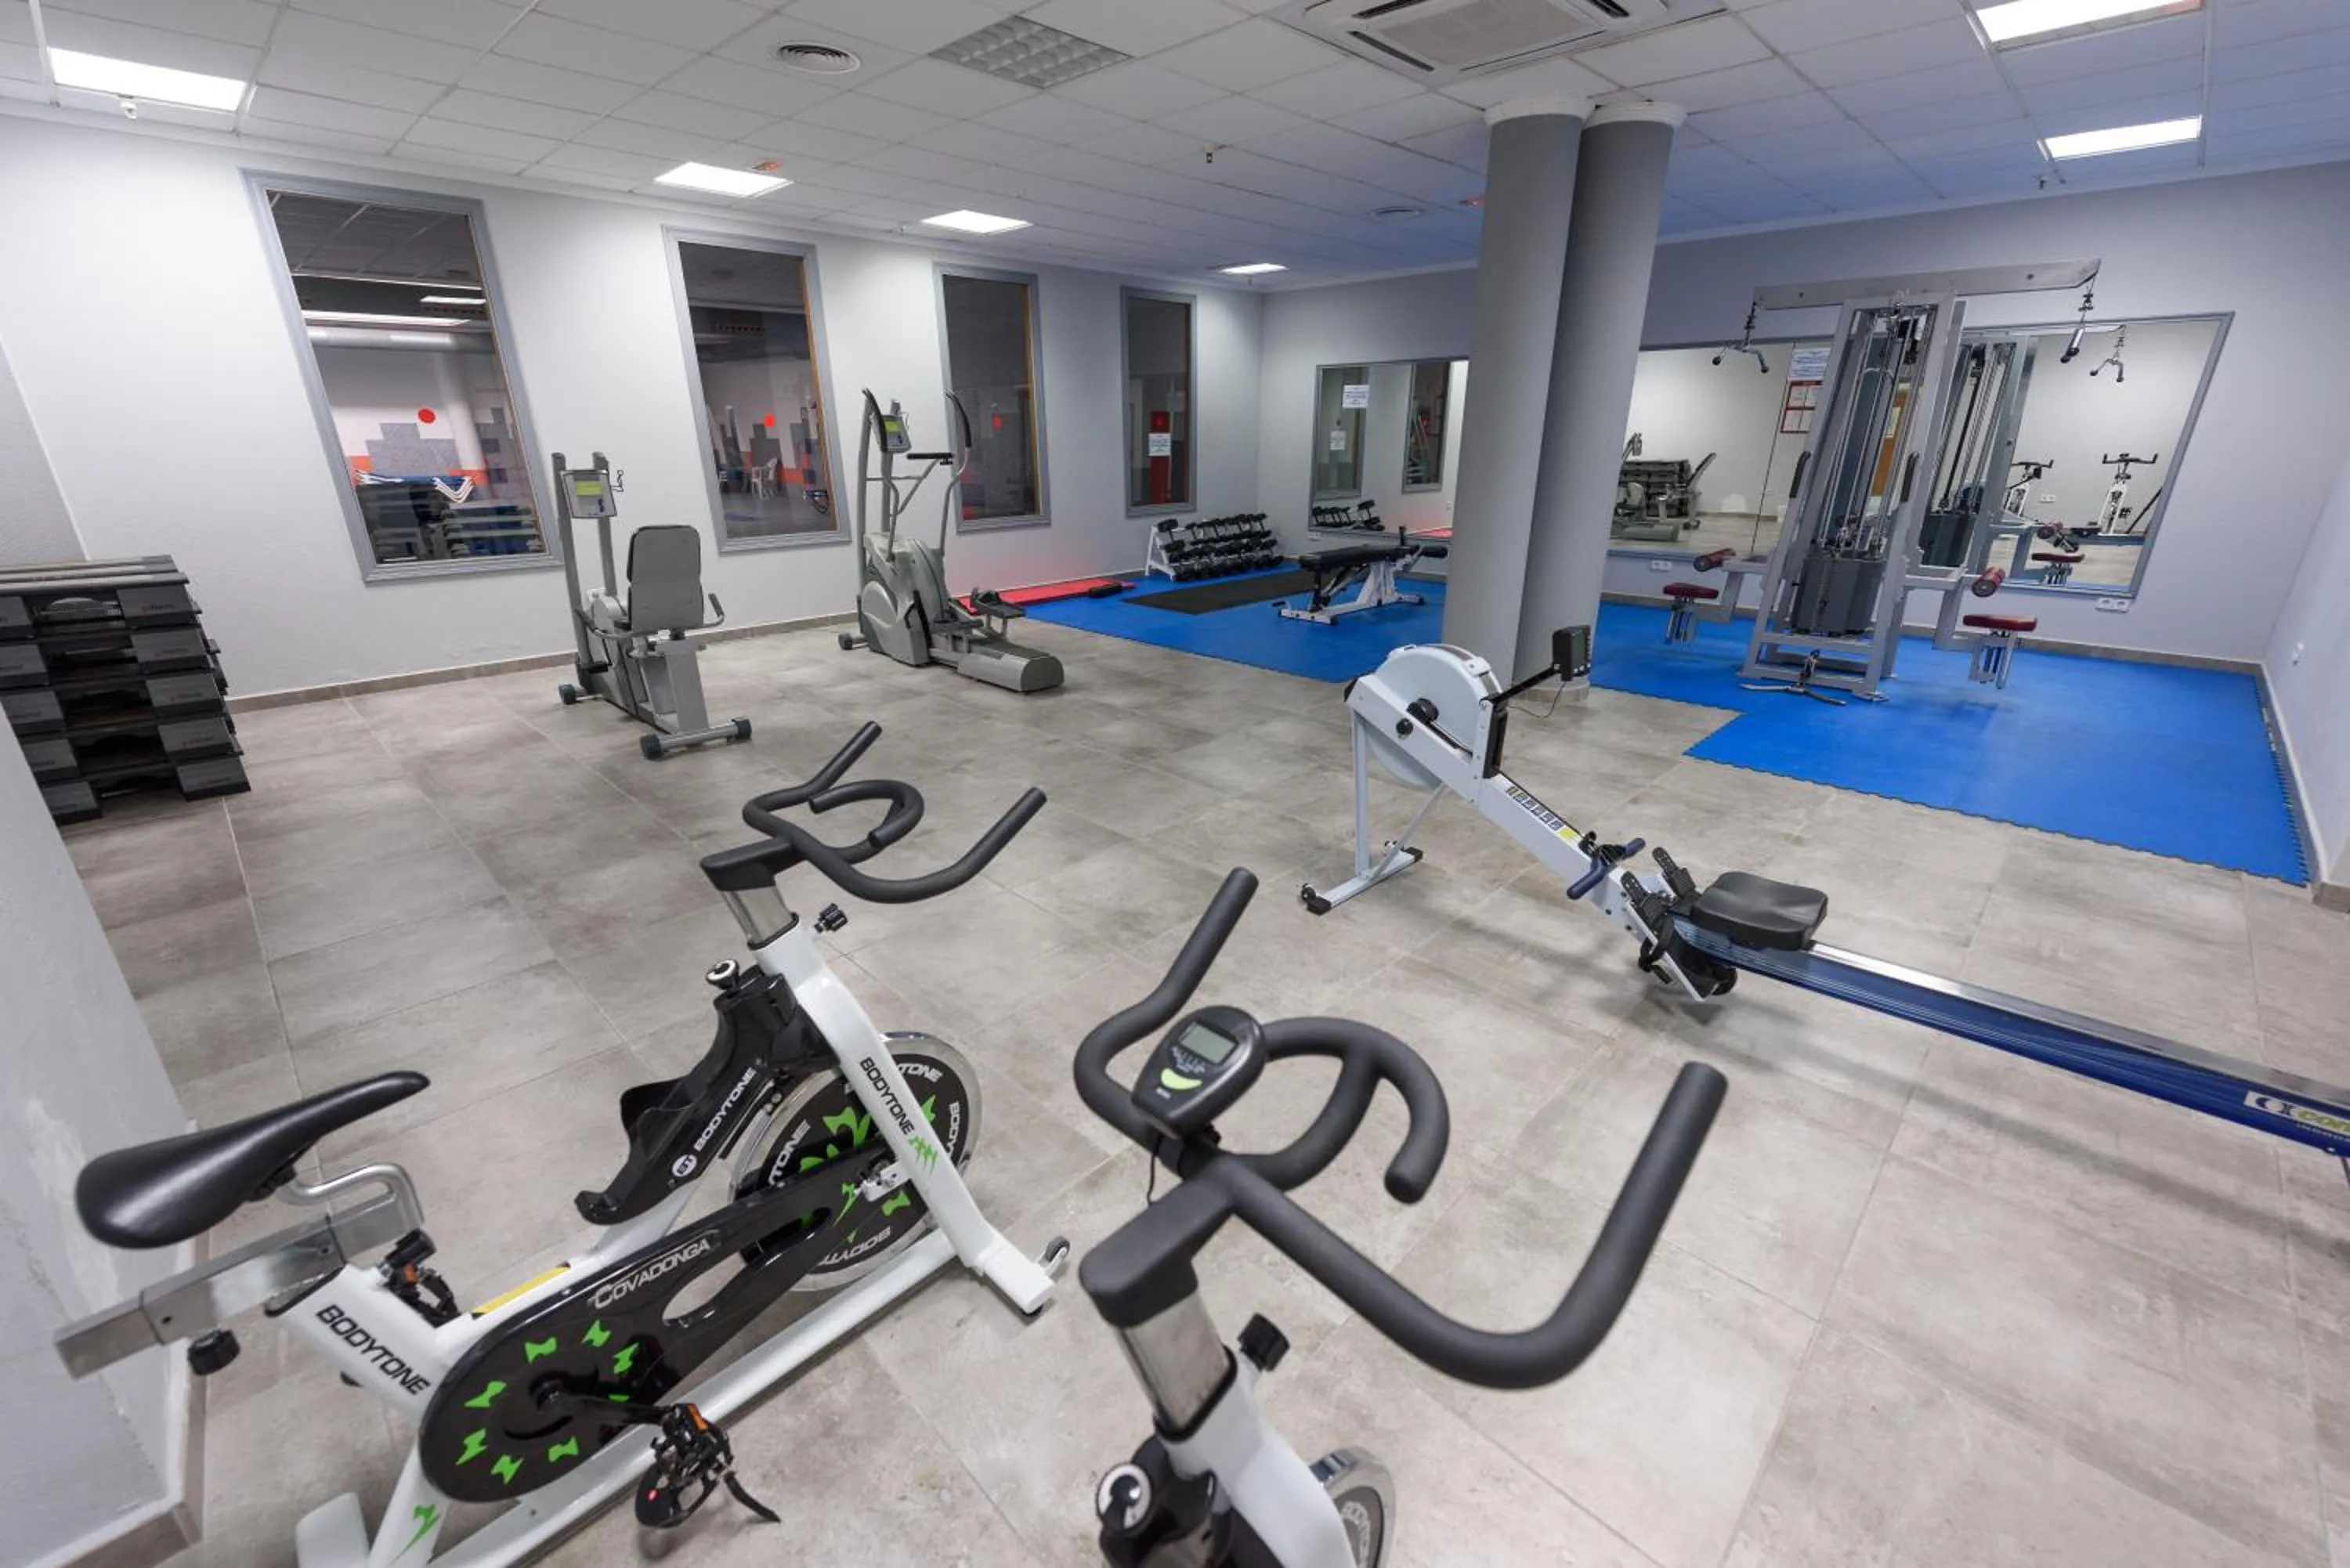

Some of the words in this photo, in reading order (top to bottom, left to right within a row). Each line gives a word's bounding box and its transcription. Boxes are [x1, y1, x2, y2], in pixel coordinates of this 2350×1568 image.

[694, 1066, 757, 1151] BODYTONE
[860, 1057, 915, 1135] BODYTONE
[897, 1063, 942, 1083] TONE
[947, 1101, 960, 1158] BODY
[594, 1239, 710, 1310] COVADONGA
[316, 1304, 431, 1395] BODYTONE
